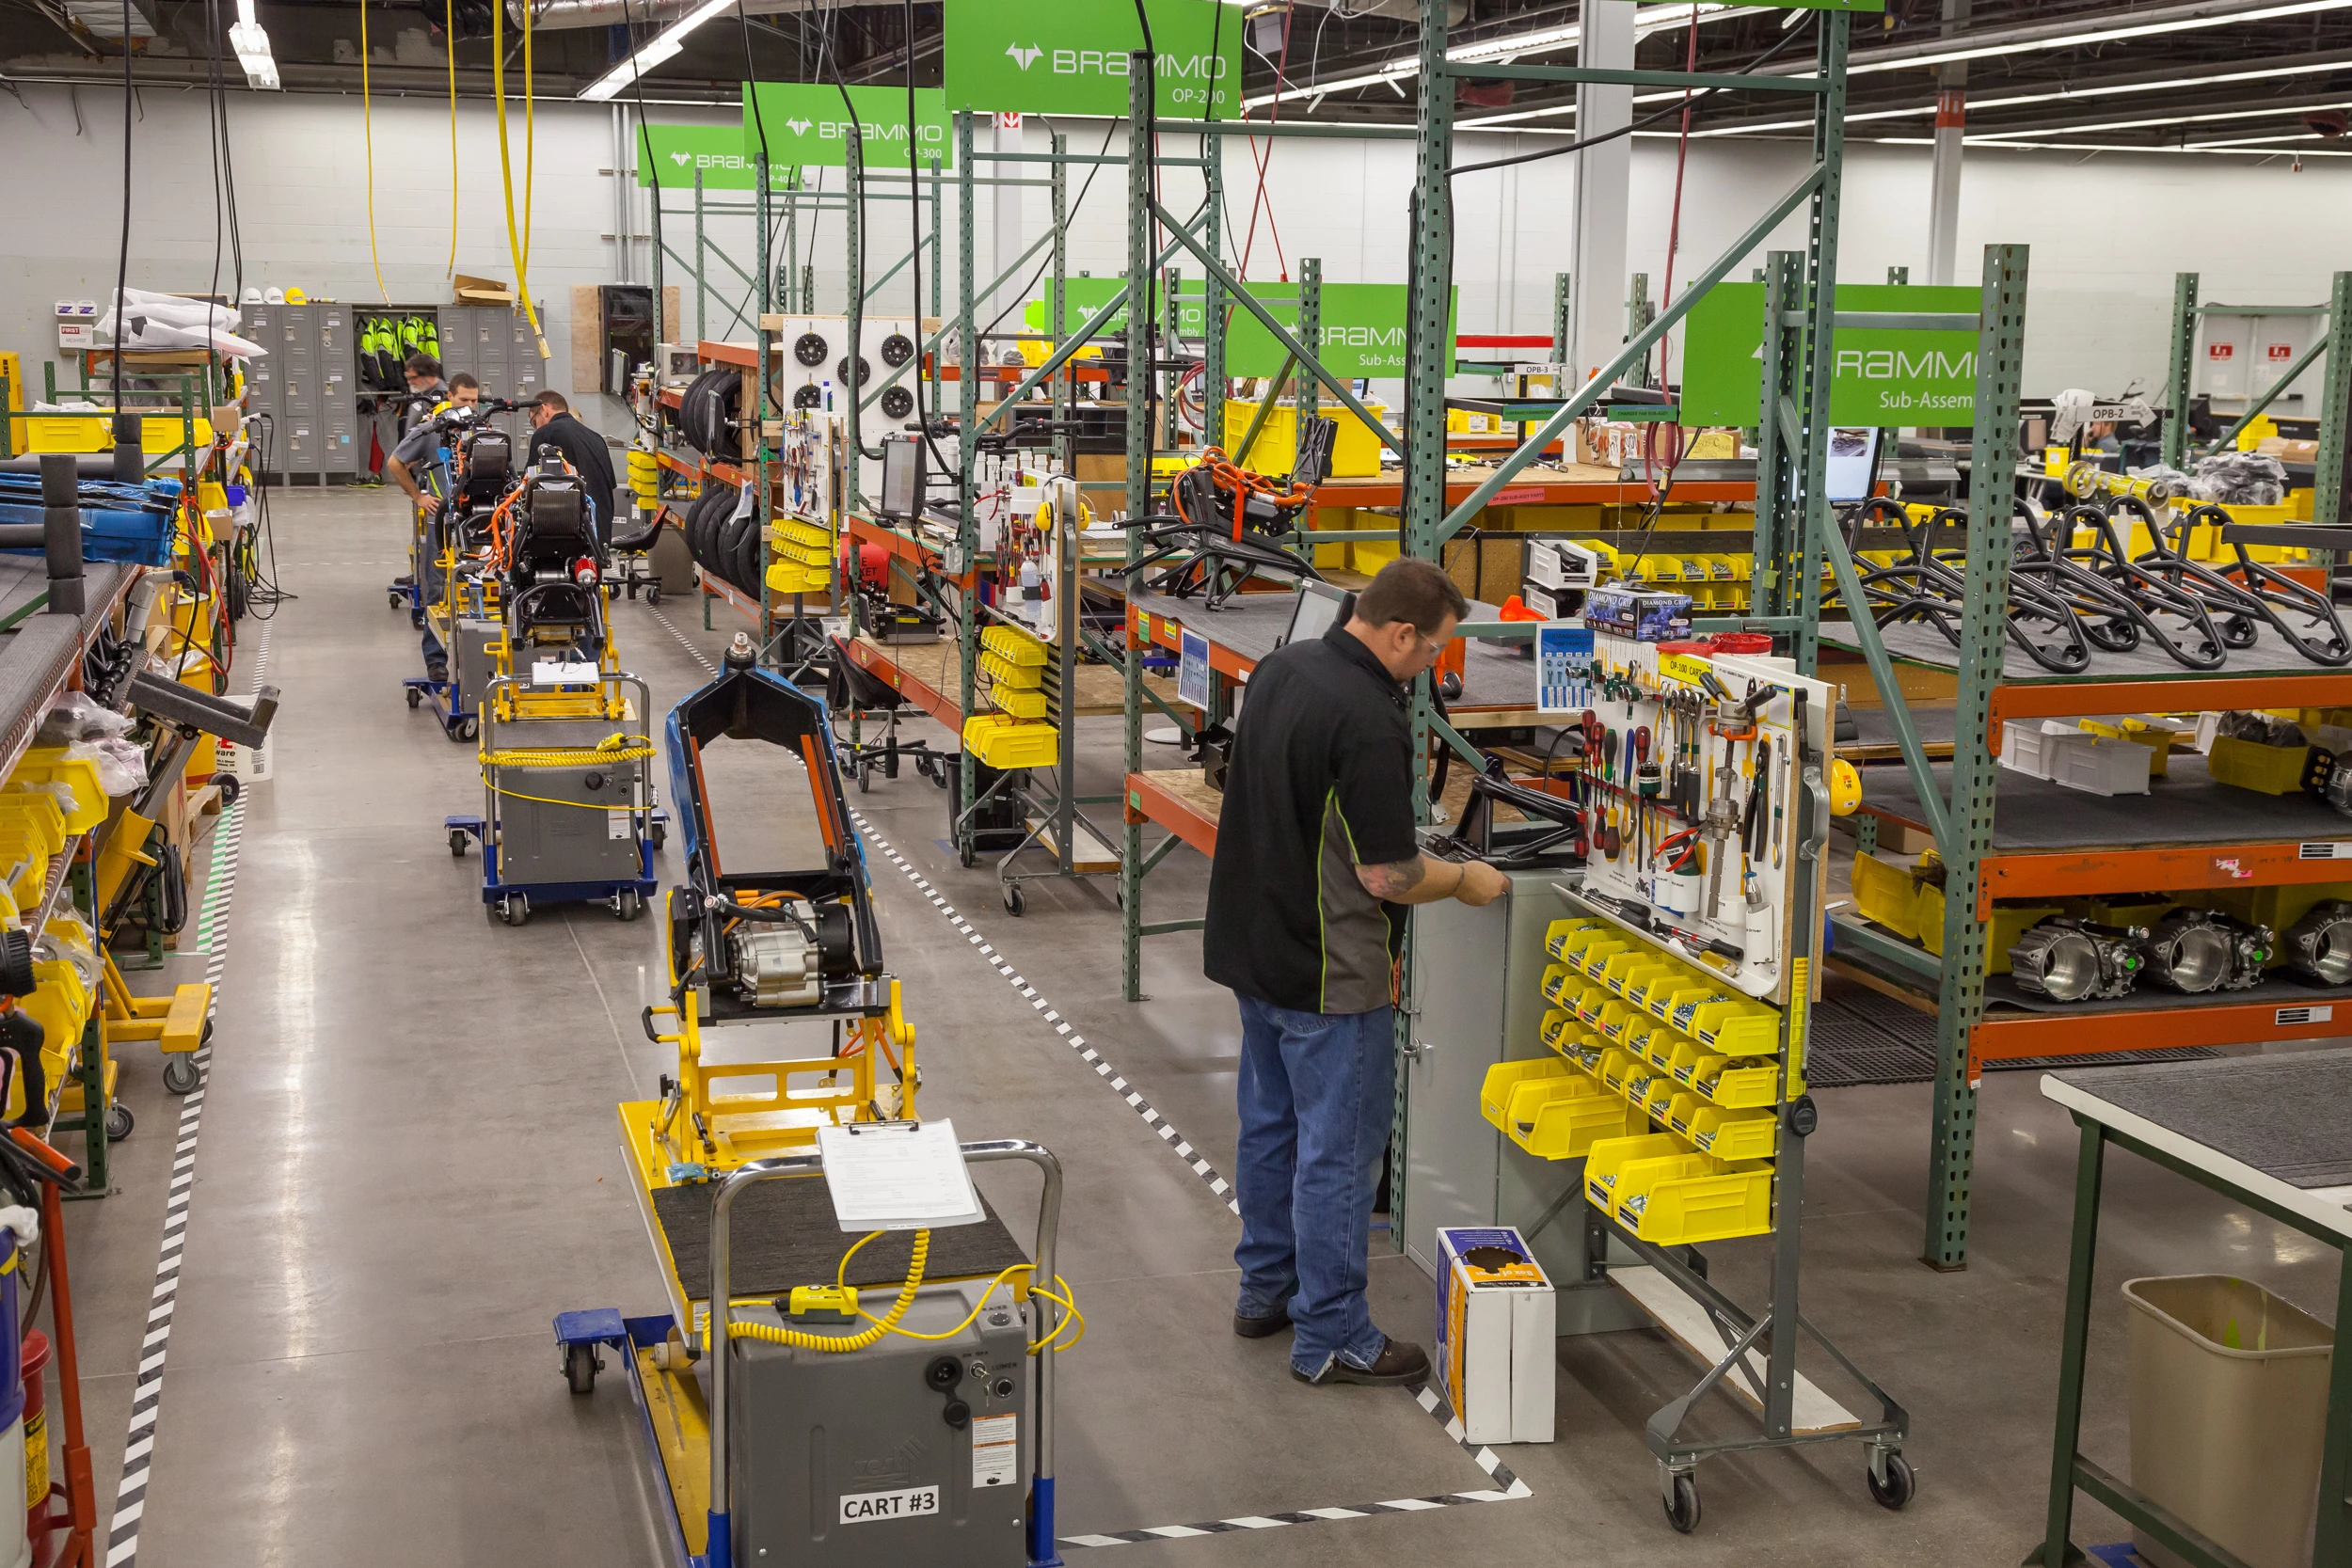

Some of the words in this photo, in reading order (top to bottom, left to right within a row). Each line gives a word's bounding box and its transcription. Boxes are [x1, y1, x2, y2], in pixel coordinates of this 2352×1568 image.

[1172, 87, 1225, 104] OP-200
[2092, 408, 2123, 420] OPB-2
[1588, 591, 1617, 605] DIAMOND
[1618, 596, 1633, 608] GRIP
[1670, 660, 1688, 673] OP-100
[1689, 666, 1702, 677] CART
[992, 1362, 1018, 1370] LOWER
[843, 1497, 903, 1519] CART
[909, 1492, 935, 1513] #3
